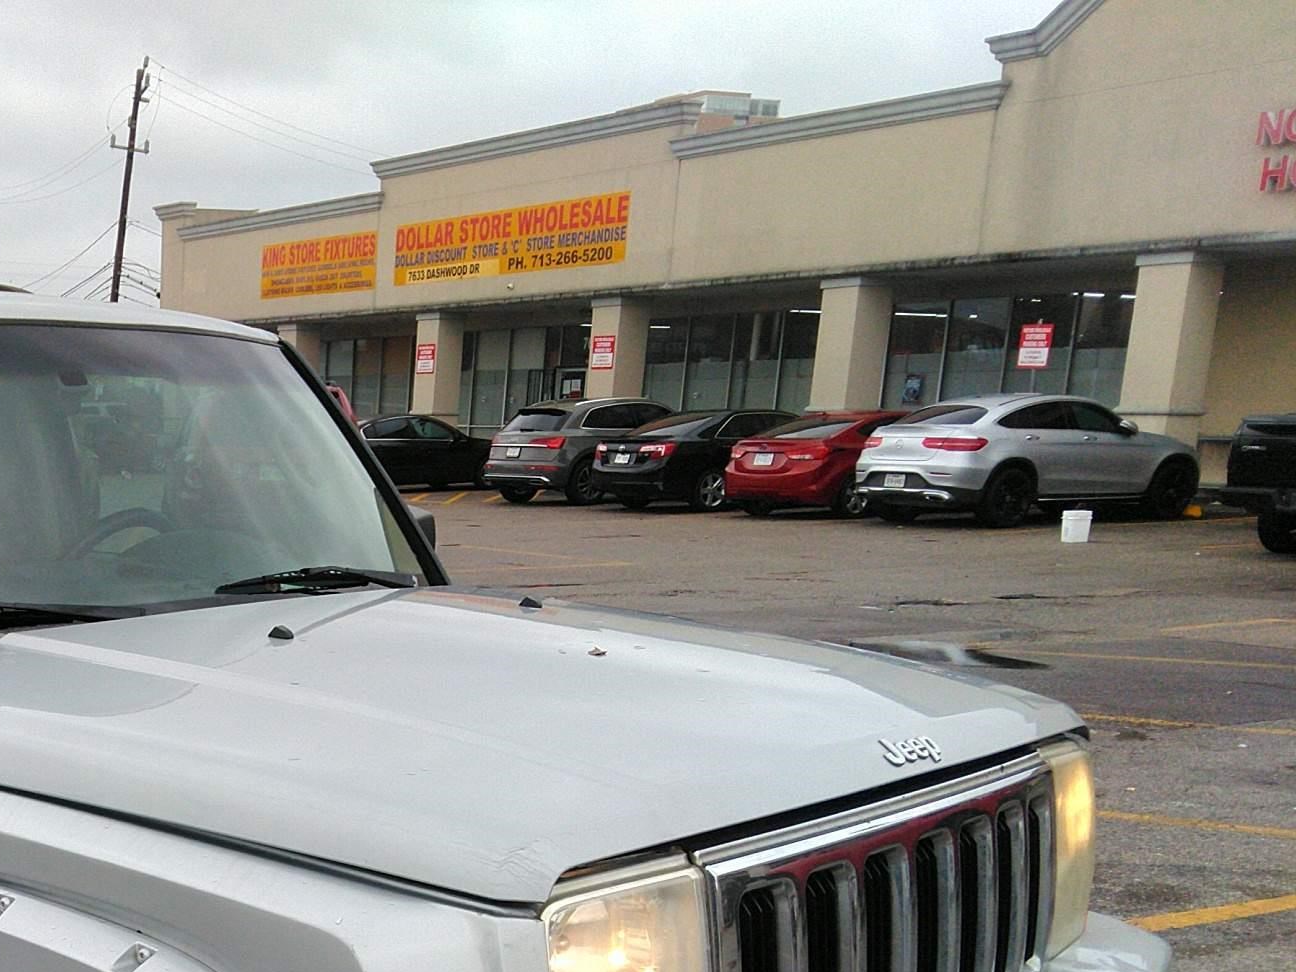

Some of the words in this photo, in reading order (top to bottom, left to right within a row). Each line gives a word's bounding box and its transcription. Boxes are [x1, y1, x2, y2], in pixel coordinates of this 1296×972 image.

[1259, 153, 1296, 192] H
[396, 222, 453, 252] DOLLAR
[460, 213, 512, 243] STORE
[518, 195, 630, 235] WHOLESALE
[262, 246, 286, 269] KING
[289, 241, 321, 265] STORE
[324, 234, 376, 261] FIXTURES
[395, 252, 425, 268] DOLLAR
[427, 246, 468, 264] DISCOUNT
[472, 242, 499, 259] STORE
[526, 235, 555, 252] STORE
[558, 225, 627, 248] MERCHANDISE
[508, 256, 527, 270] PH.
[531, 246, 613, 268] 713-266-5200
[408, 270, 426, 282] 7633
[426, 265, 468, 280] DASHWOOD
[469, 263, 480, 275] DR
[877, 736, 942, 767] Jeep
